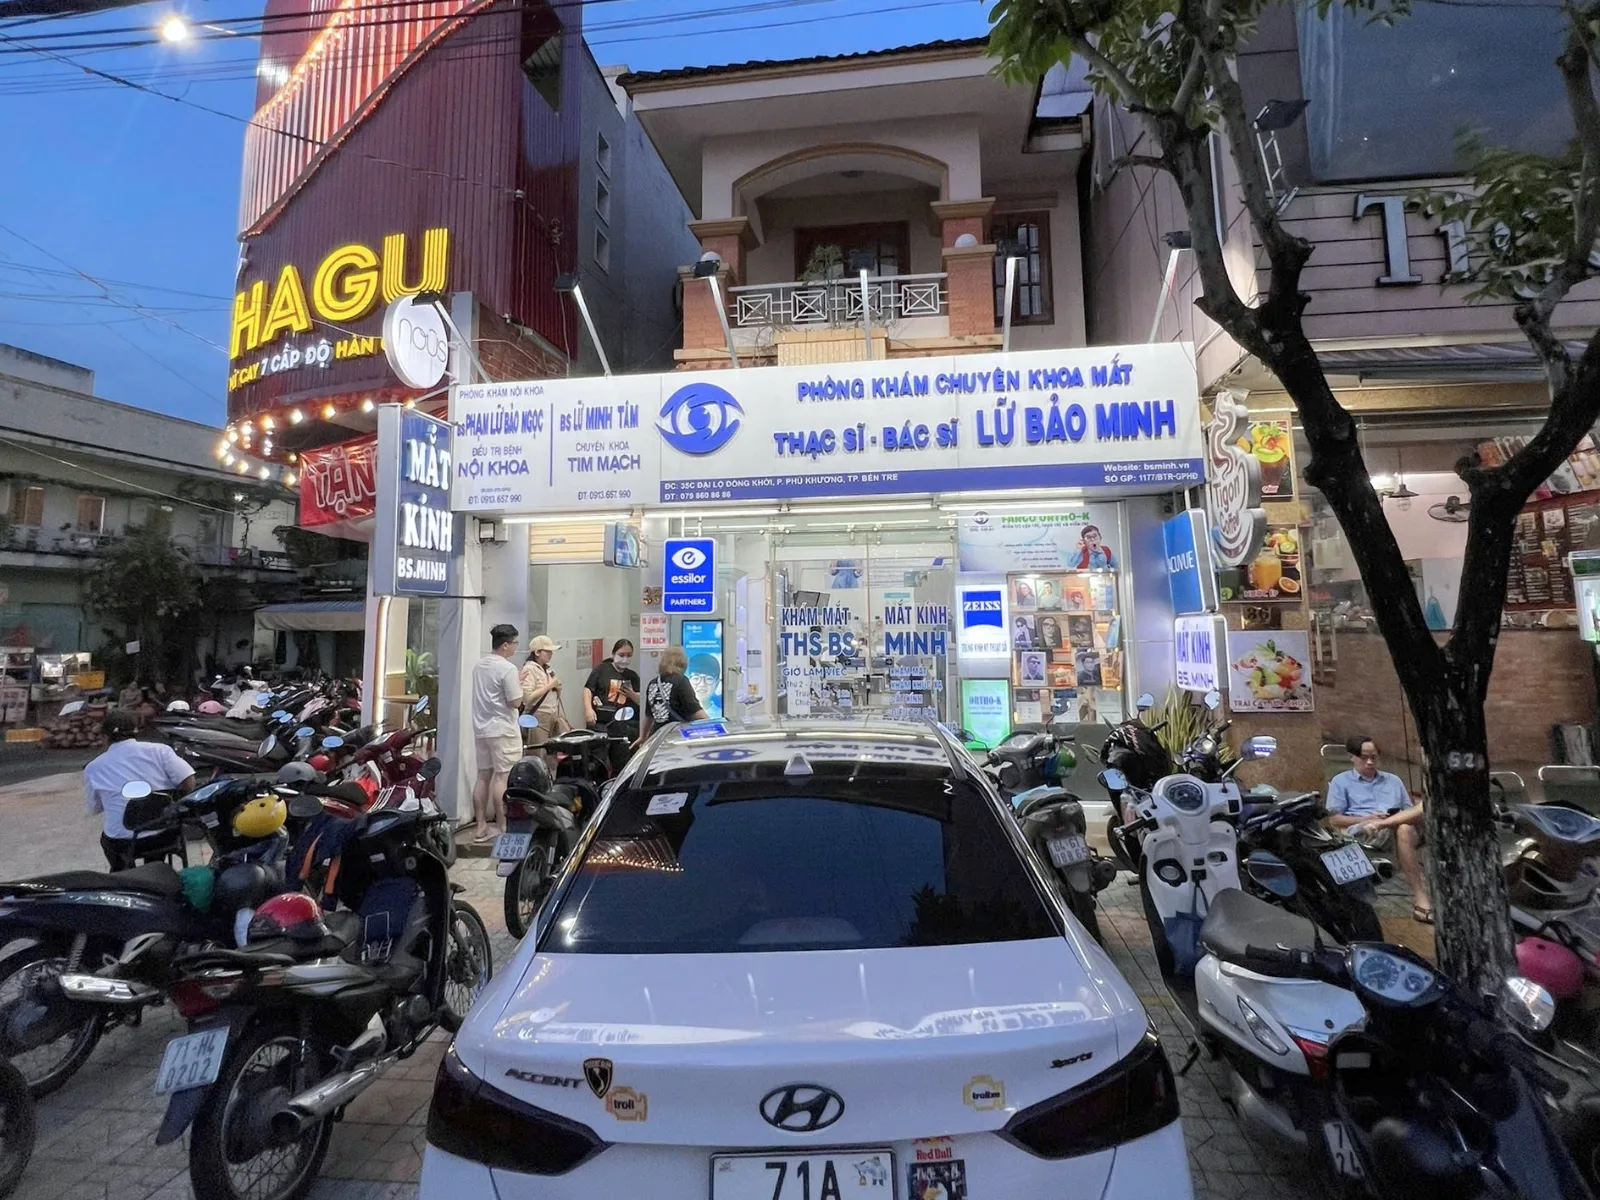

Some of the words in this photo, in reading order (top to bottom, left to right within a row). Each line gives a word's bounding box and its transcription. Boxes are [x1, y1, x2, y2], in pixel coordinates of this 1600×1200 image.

[230, 228, 449, 360] HAGU
[240, 361, 260, 384] CAY
[261, 357, 269, 376] 7
[270, 342, 301, 372] CẤP
[305, 339, 331, 368] ĐỘ
[797, 375, 865, 402] PHÒNG
[872, 371, 929, 398] KHÁM
[935, 367, 1021, 395] CHUYÊN
[1028, 366, 1084, 389] KHOA
[1092, 353, 1133, 387] MẮT
[459, 388, 484, 399] PHÒNG
[487, 387, 508, 398] KHÁM
[510, 386, 522, 398] NỘI
[524, 386, 545, 396] KHOA
[466, 412, 489, 442] PHẠM
[521, 408, 544, 439] NGỌC
[560, 413, 572, 432] BS
[586, 405, 613, 430] MINH
[617, 400, 640, 429] TÂM
[773, 428, 836, 460] THẠC
[843, 423, 866, 453] SĨ
[882, 420, 930, 451] BÁC
[936, 418, 959, 448] SĨ
[976, 397, 1017, 447] LỮ
[1024, 393, 1087, 445] BẢO
[1095, 399, 1177, 441] MINH
[504, 444, 522, 457] BỆNH
[576, 441, 605, 452] CHUYÊN
[609, 441, 629, 451] KHOA
[458, 458, 483, 479] NỘI
[488, 459, 530, 476] KHOA
[568, 456, 593, 473] TIM
[597, 454, 641, 474] MẠCH
[1103, 463, 1141, 472] Website:
[1143, 462, 1190, 471] bsminh.vn
[308, 447, 378, 514] TẶN
[680, 482, 695, 490] 35C
[777, 478, 784, 486] P.
[848, 475, 860, 483] TP.
[881, 473, 899, 481] TRE
[1120, 474, 1137, 482] GP:
[680, 492, 694, 500] 079
[1213, 475, 1240, 511] Tigon
[403, 493, 453, 552] KÍNH
[398, 557, 447, 582] BS.MINH
[671, 573, 706, 584] essilor
[670, 598, 707, 606] PARTNERS
[782, 602, 818, 626] KHÁM
[823, 601, 850, 626] MẮT
[885, 599, 912, 625] MẮT
[917, 601, 948, 625] KÍNH
[964, 600, 1001, 611] ZEISS
[781, 632, 823, 657] THS
[829, 632, 856, 657] BS
[885, 631, 947, 656] MINH
[1191, 623, 1212, 665] KÍNH
[783, 665, 801, 676] GIỜ
[969, 696, 1002, 705] ORTHO-K
[165, 1057, 212, 1089] 0202
[505, 1068, 586, 1089] ACCENT
[916, 1148, 934, 1160] Red
[935, 1147, 953, 1159] Bull
[765, 1160, 842, 1200] 71A
